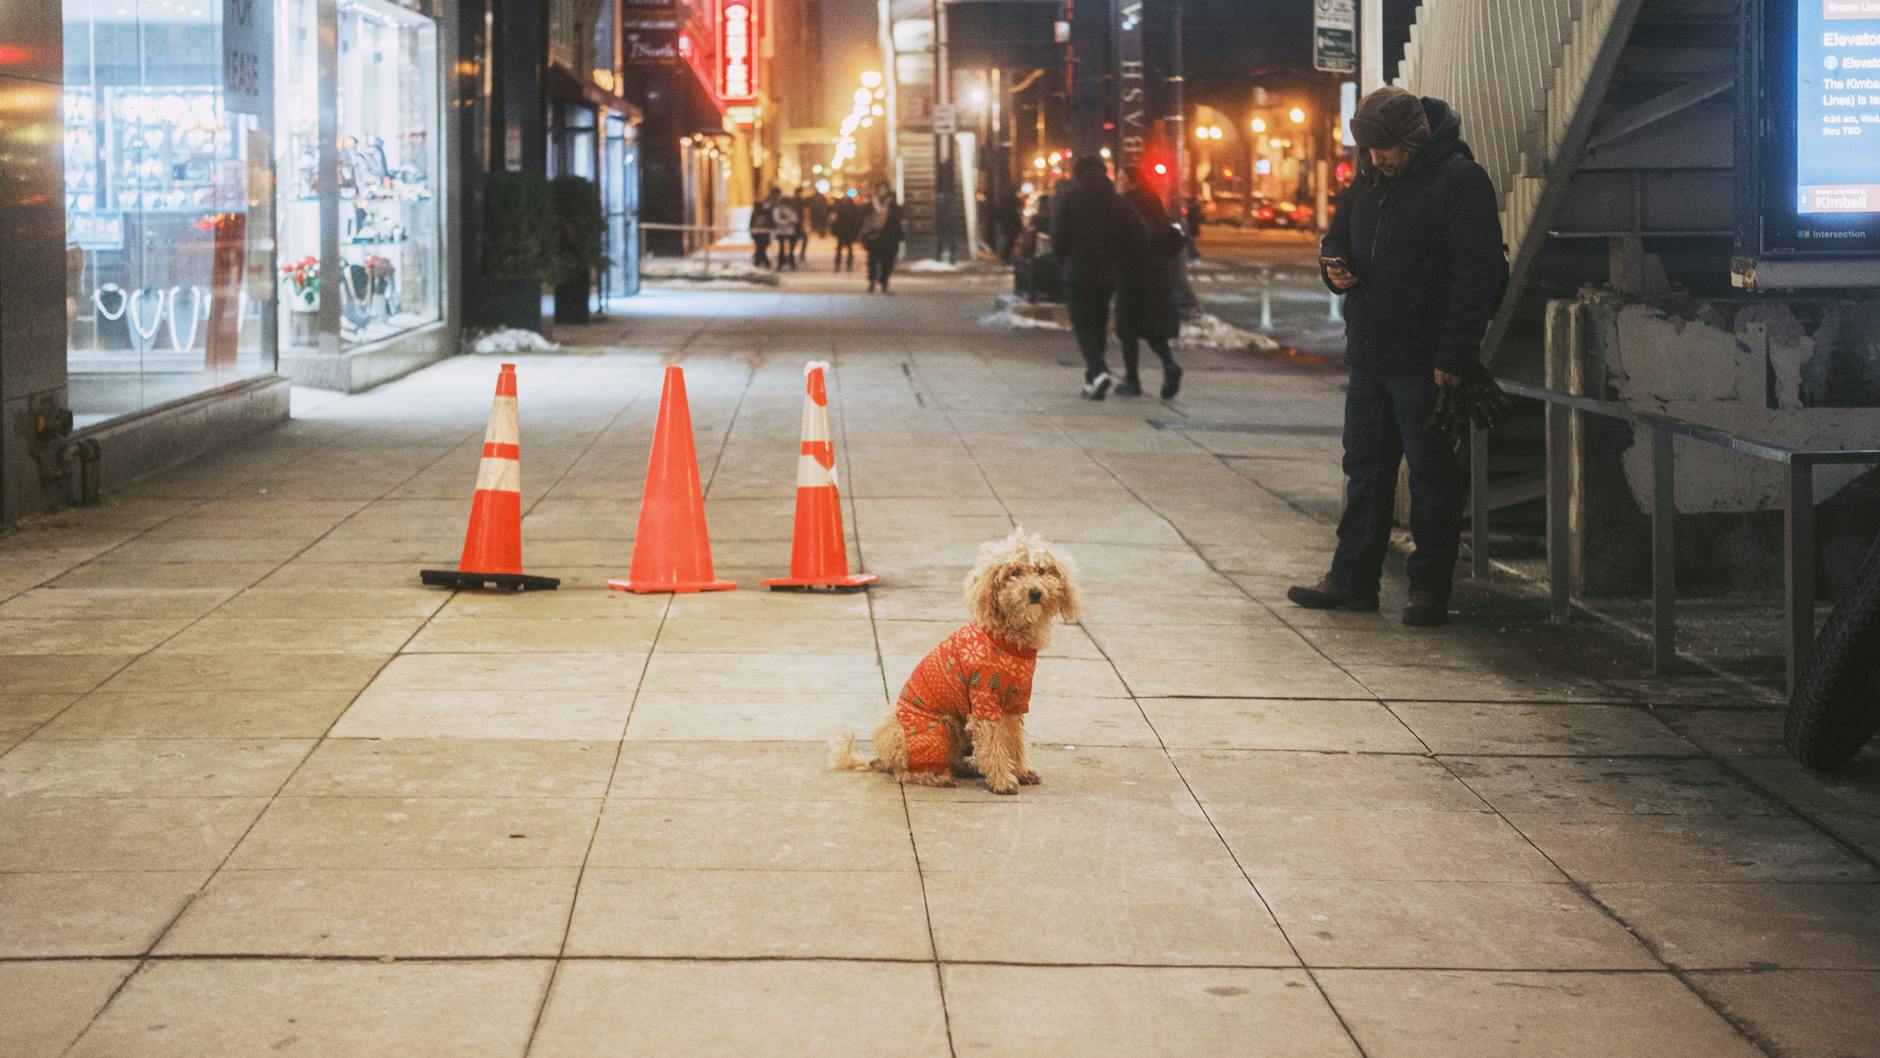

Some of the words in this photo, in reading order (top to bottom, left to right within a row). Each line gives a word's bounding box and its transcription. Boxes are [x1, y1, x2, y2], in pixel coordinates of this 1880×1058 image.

[1823, 78, 1843, 90] The
[1121, 60, 1143, 153] BASH
[1815, 195, 1867, 209] Kimball
[1813, 229, 1866, 239] Intersection
